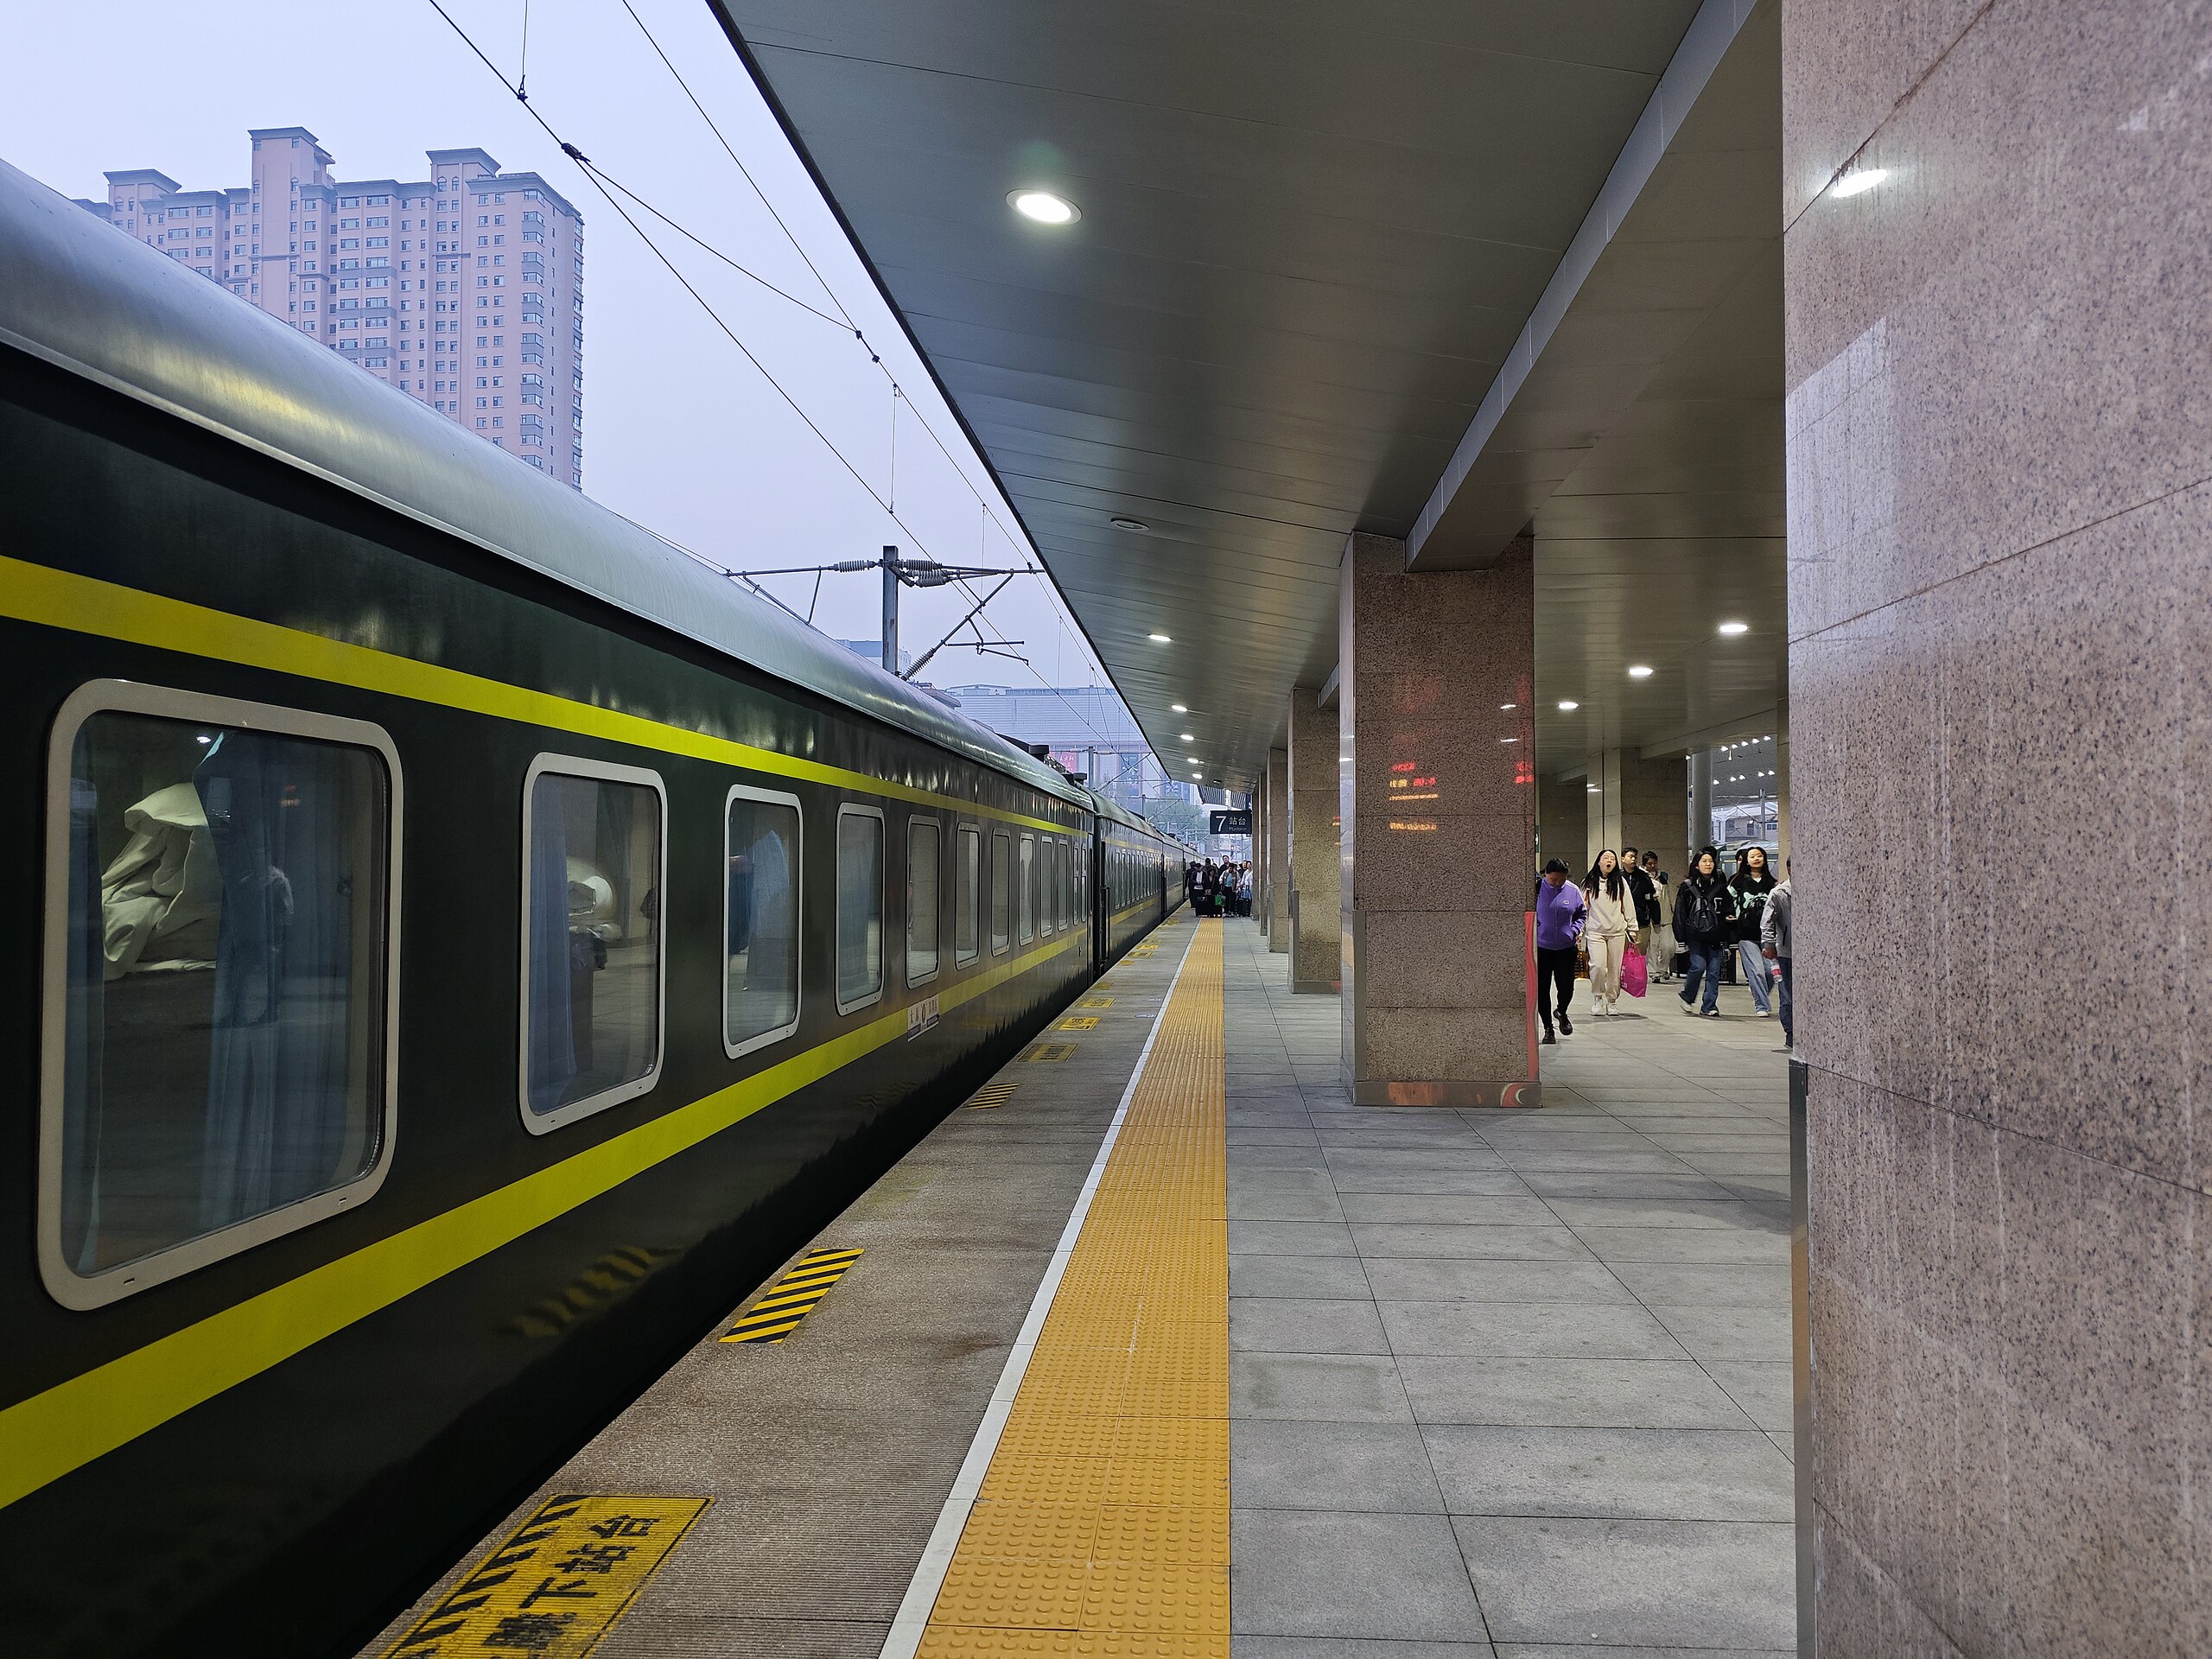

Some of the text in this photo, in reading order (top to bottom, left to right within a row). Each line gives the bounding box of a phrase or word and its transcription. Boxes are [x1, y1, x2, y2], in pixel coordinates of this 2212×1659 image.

[1216, 816, 1227, 832] 7
[1229, 817, 1246, 825] 站台
[483, 1514, 659, 1659] 跳下站台
